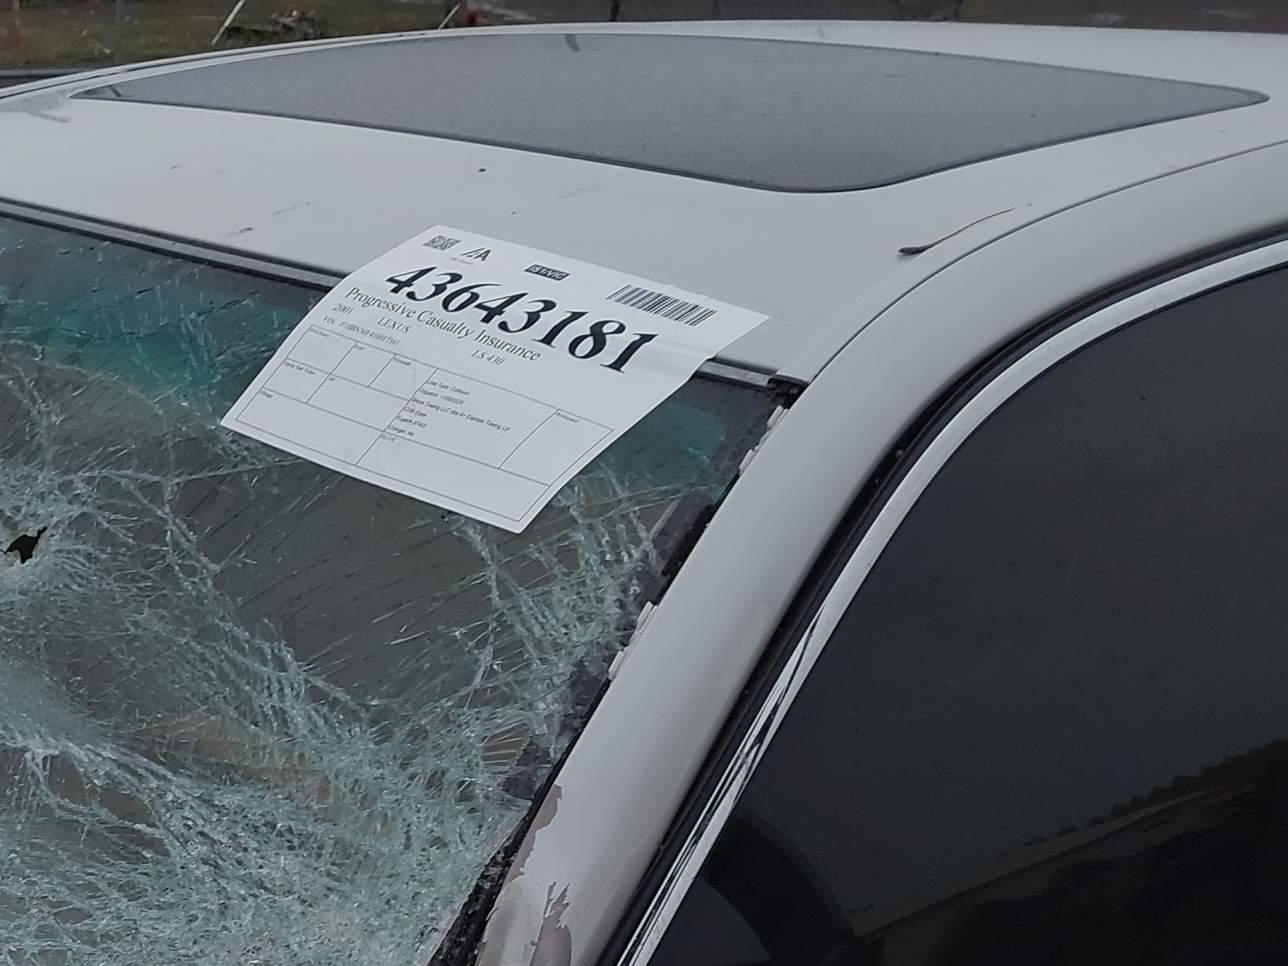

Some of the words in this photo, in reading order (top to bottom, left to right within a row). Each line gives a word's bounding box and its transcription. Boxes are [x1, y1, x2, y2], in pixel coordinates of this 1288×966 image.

[345, 287, 416, 319] Progressive
[417, 310, 474, 340] Casualty
[474, 328, 542, 361] Insurance
[377, 316, 410, 334] LEXUS
[486, 354, 505, 366] 430
[385, 266, 659, 374] 43643181
